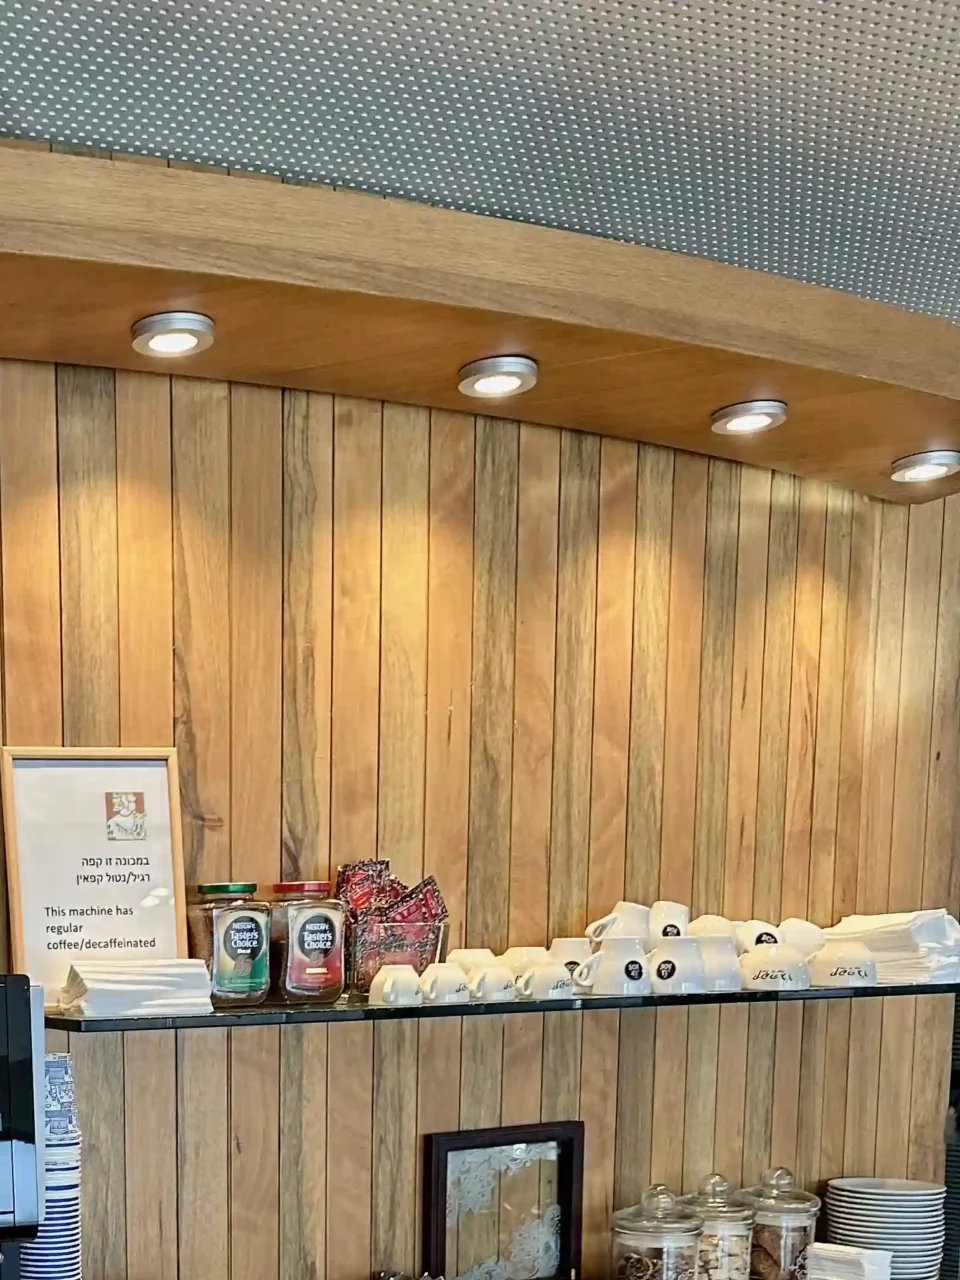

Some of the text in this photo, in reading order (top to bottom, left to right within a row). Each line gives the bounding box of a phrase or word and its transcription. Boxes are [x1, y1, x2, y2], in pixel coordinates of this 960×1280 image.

[82, 857, 149, 869] במכונה זו קפה
[76, 871, 150, 886] רגיל/נטול קפאין
[44, 905, 134, 917] This machine has
[46, 922, 83, 935] regular
[230, 929, 259, 940] Taster's
[302, 930, 333, 942] Taster's
[46, 936, 156, 951] coffee/decaffeinated
[231, 939, 259, 948] Choice
[304, 941, 332, 949] Choice
